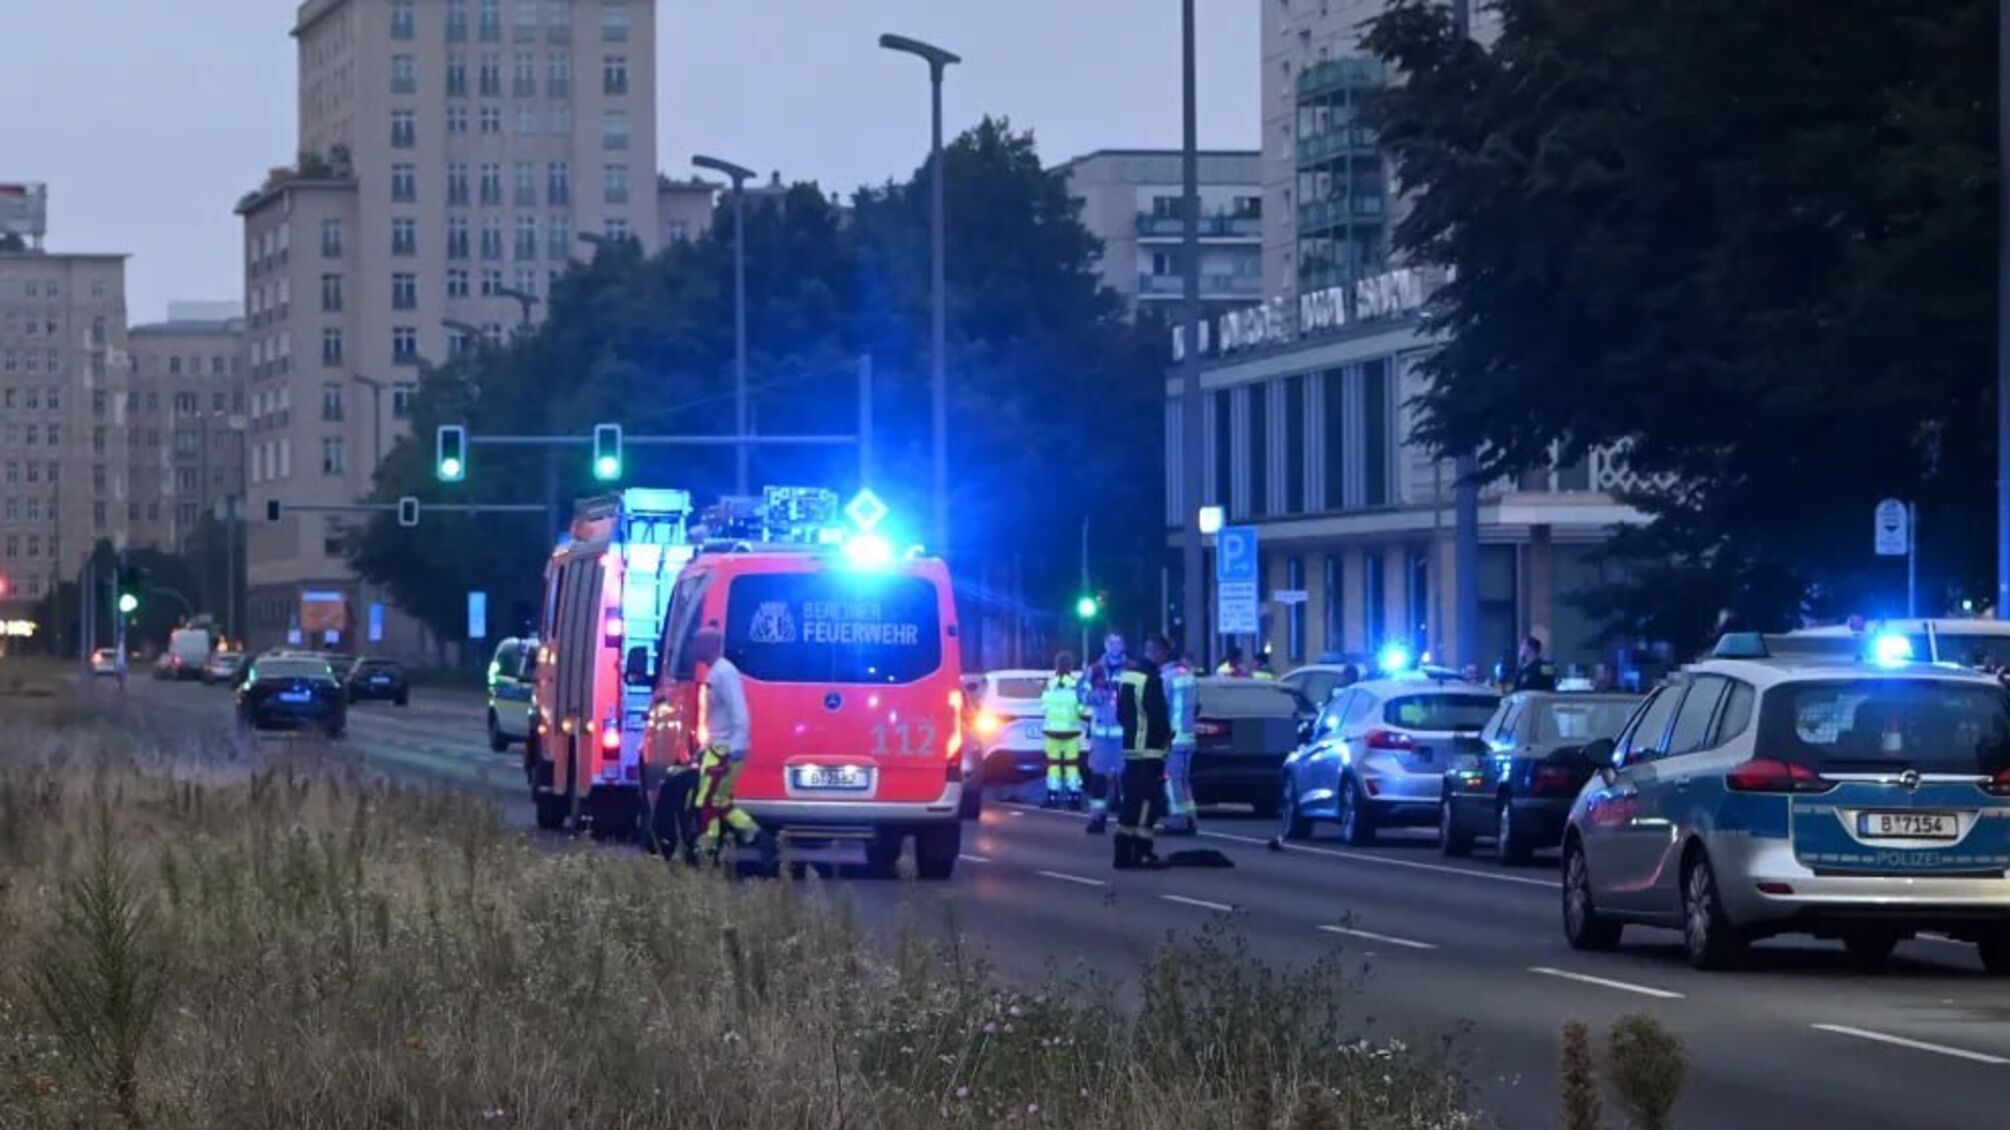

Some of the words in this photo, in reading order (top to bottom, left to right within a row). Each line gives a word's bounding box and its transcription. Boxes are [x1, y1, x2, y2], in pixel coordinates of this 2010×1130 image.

[1222, 534, 1245, 576] P
[803, 621, 919, 645] FEUERWEHR
[871, 719, 936, 757] 112
[1876, 851, 1941, 866] POLIZEI
